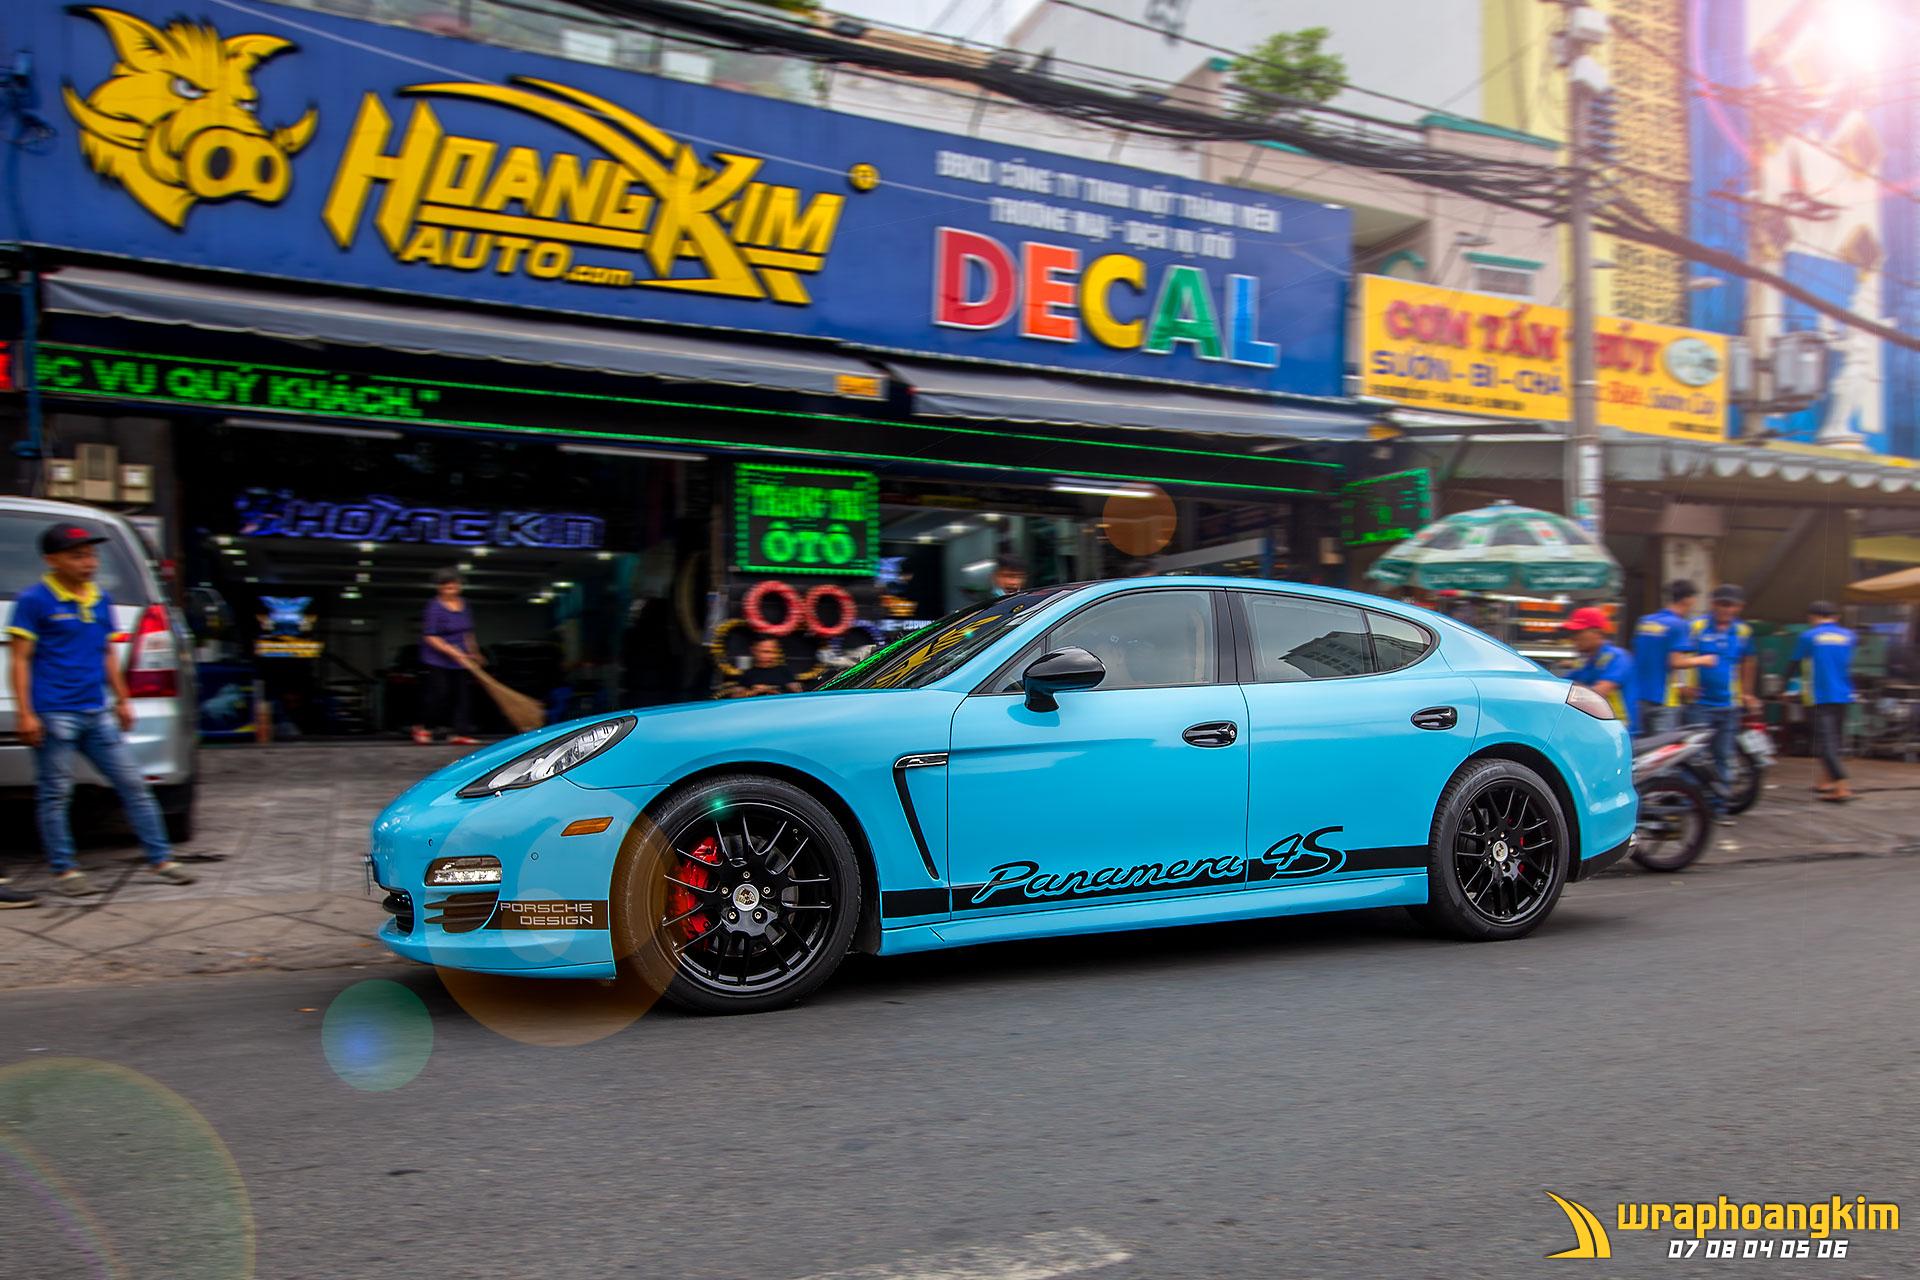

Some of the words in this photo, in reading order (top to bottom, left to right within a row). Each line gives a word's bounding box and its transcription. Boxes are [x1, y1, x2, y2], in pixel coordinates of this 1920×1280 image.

[932, 225, 1281, 368] DECAL
[1384, 299, 1470, 350] CƠM
[761, 520, 857, 564] ÔTÔ
[970, 855, 1246, 905] Panamera
[1261, 825, 1346, 881] 4S
[499, 902, 594, 914] PORSCHE
[519, 915, 594, 926] DESIGN
